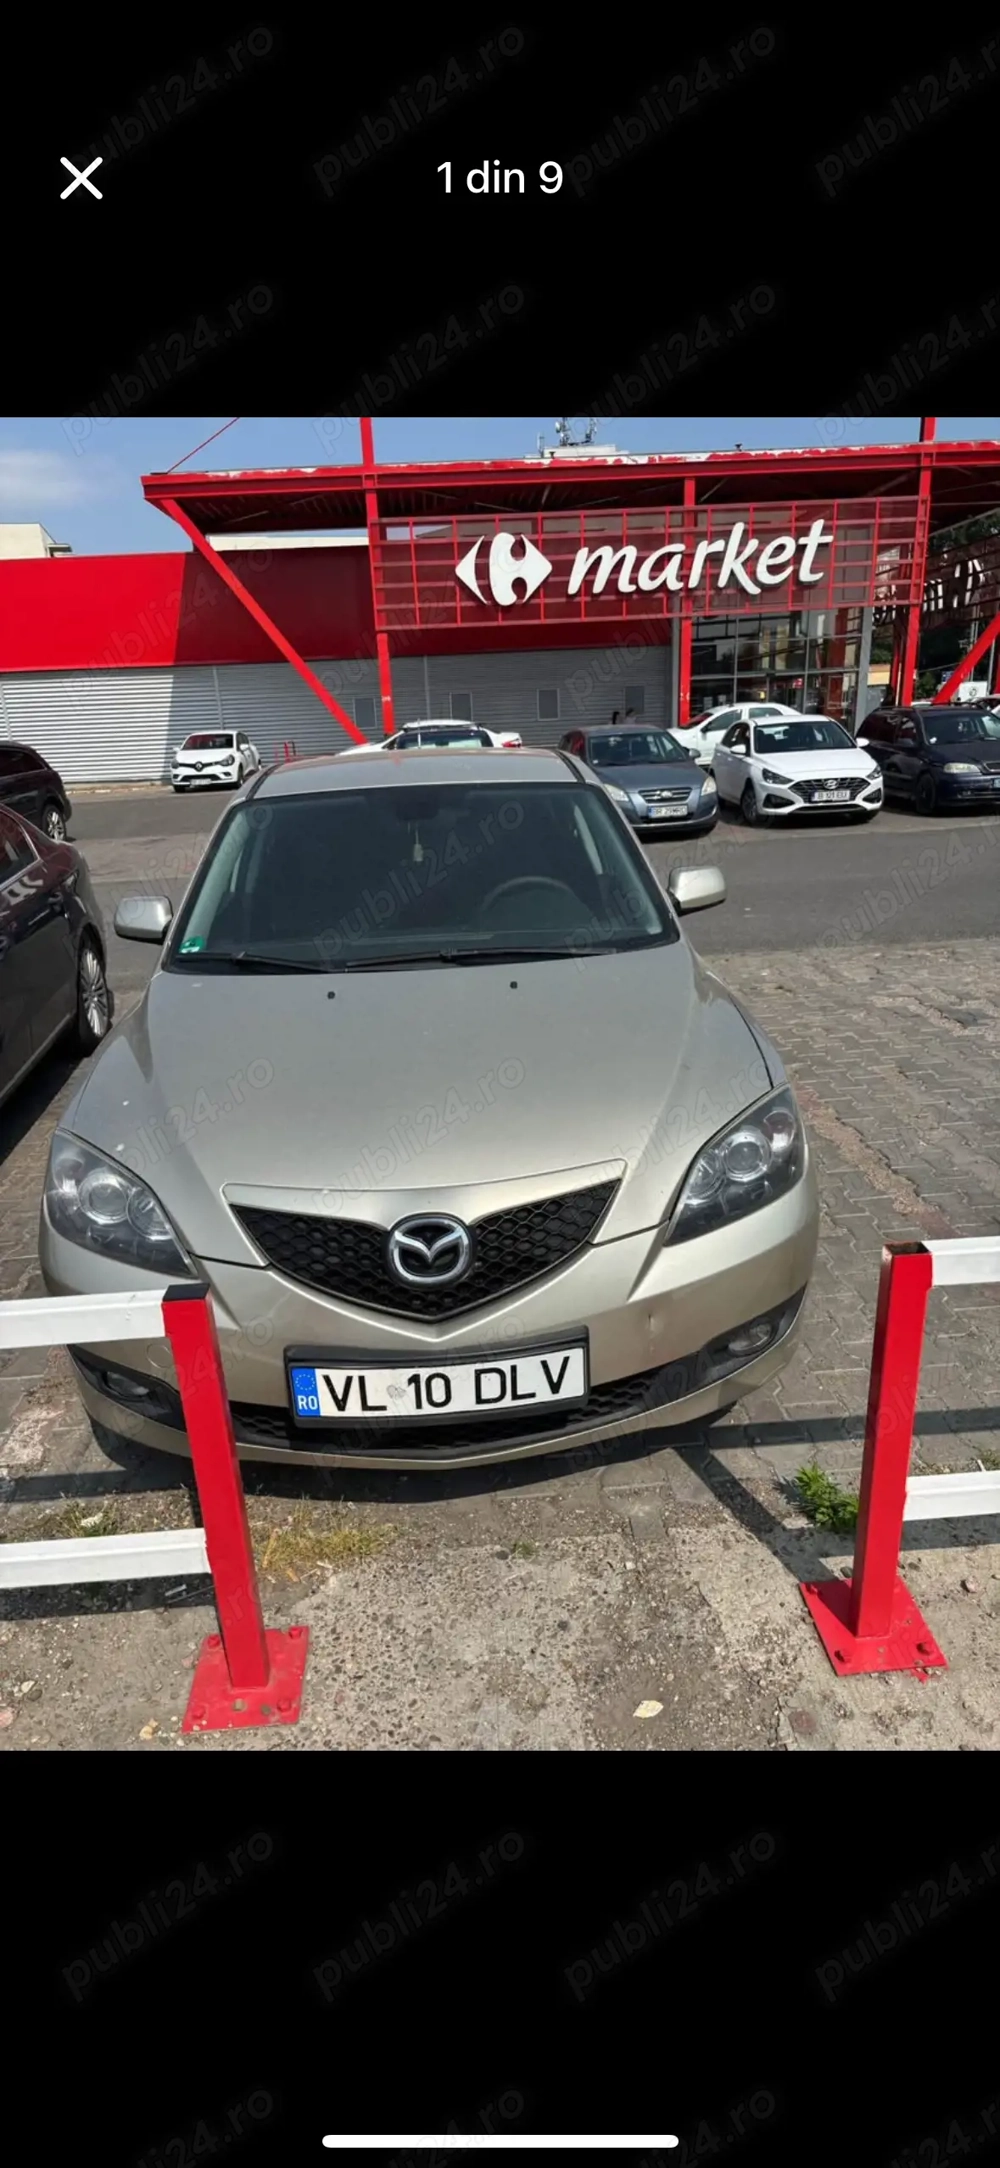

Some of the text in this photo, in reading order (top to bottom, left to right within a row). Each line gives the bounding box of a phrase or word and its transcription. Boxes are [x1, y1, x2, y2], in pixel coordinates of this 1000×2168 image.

[568, 518, 834, 597] market
[297, 1356, 570, 1412] RO VL 10 DLV
